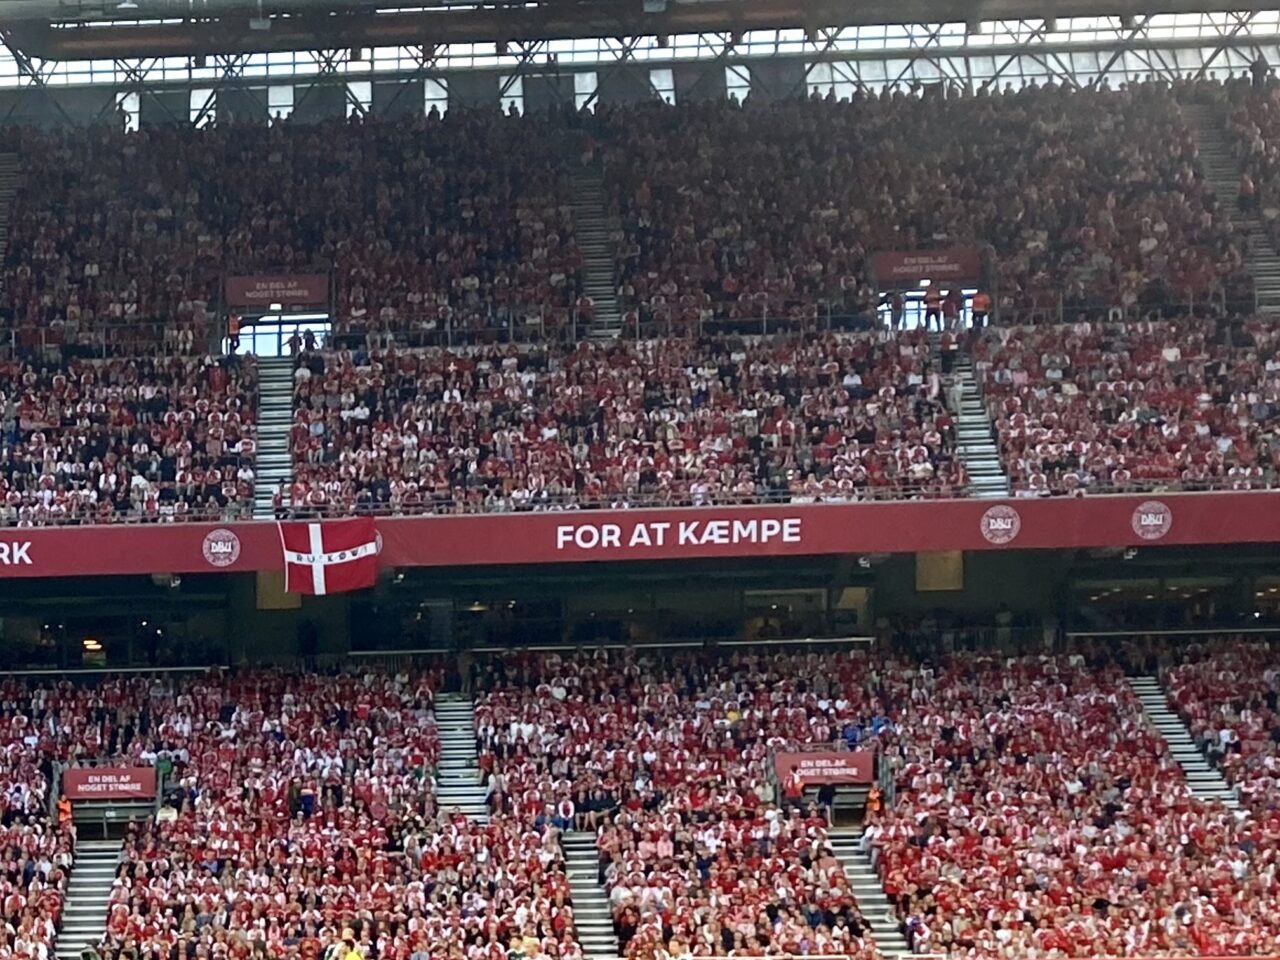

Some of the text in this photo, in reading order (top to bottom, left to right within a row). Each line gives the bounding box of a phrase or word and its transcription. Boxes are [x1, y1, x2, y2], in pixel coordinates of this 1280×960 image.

[557, 518, 802, 549] FOR AT KÆMPE
[796, 768, 821, 776] OGET
[88, 775, 100, 783] EN
[77, 783, 107, 791] NOGET
